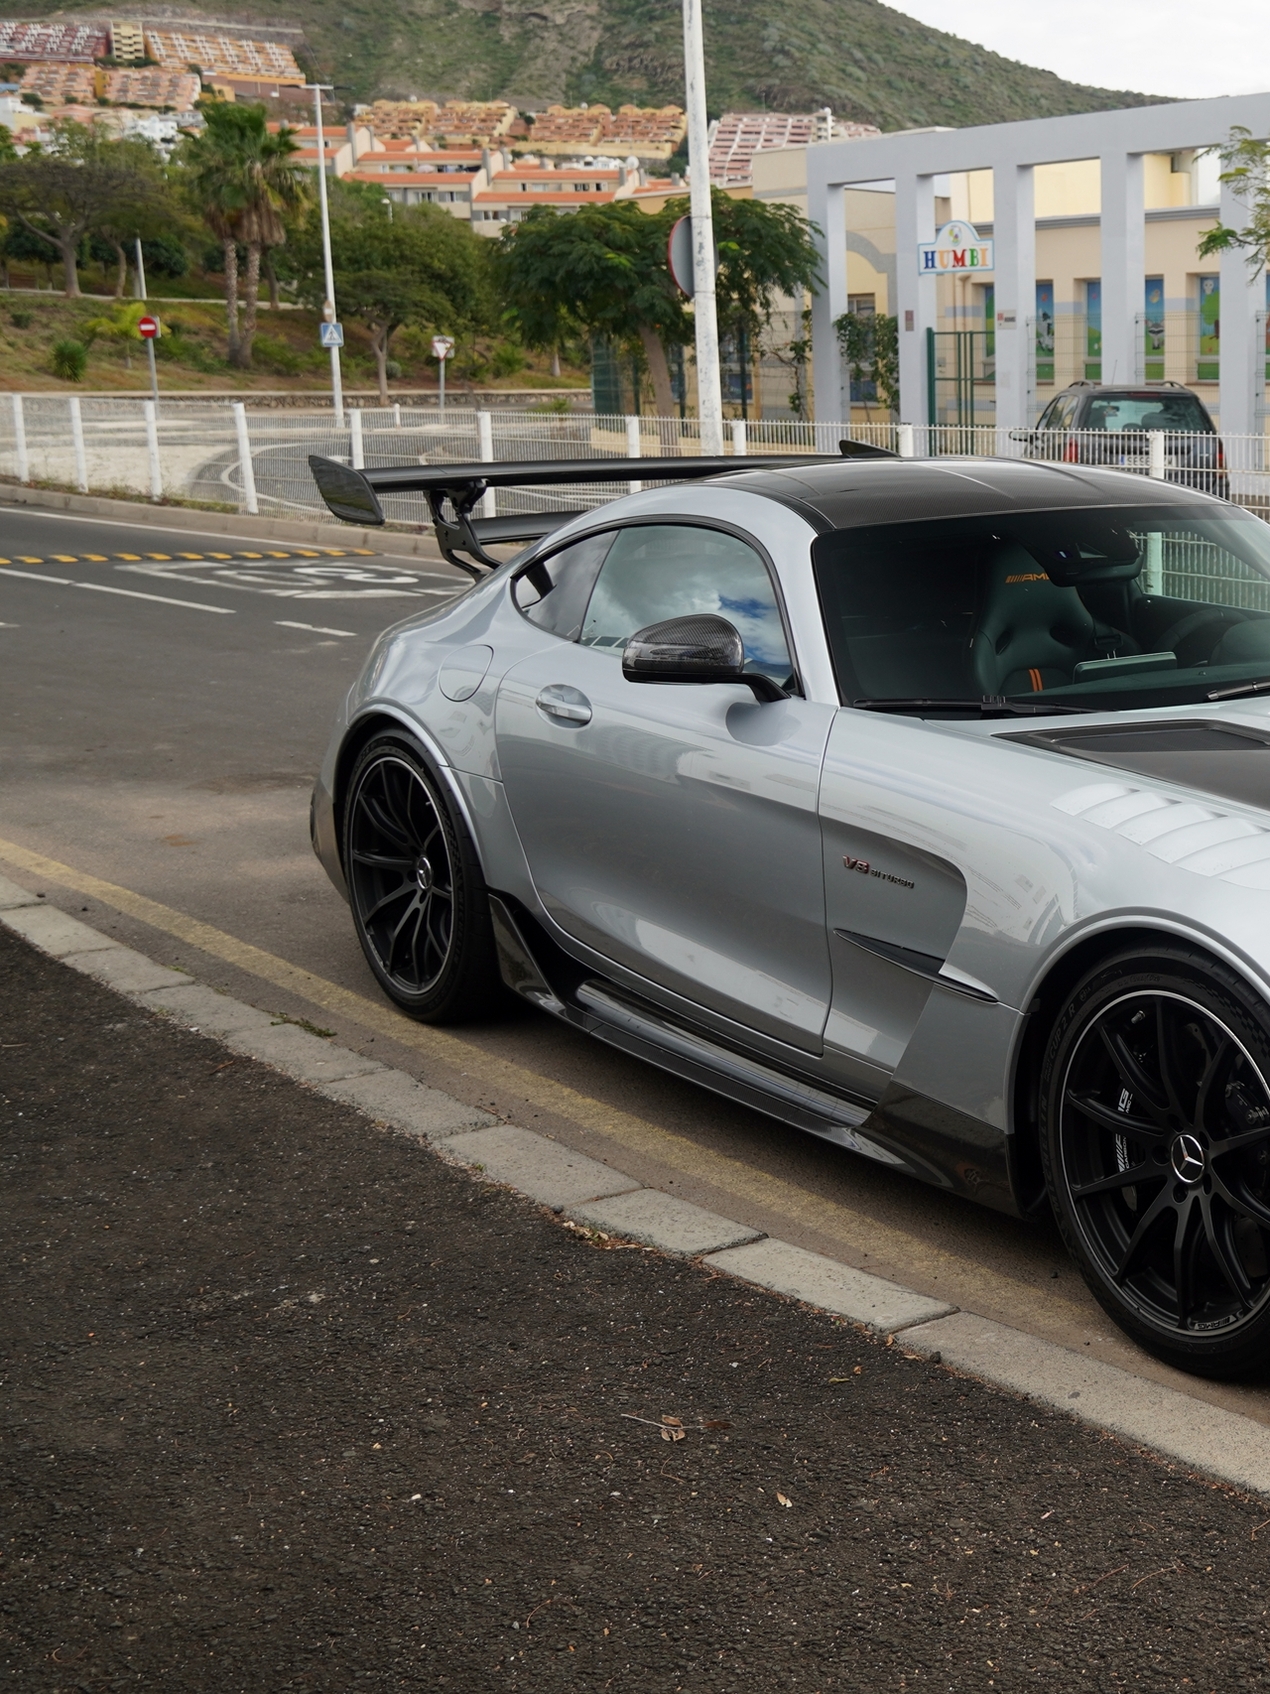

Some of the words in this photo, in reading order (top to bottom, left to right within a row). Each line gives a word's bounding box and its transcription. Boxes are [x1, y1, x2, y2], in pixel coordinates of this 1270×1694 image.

[923, 248, 988, 269] HUMBI
[842, 855, 870, 875] V8
[870, 868, 915, 889] BITURBO
[1047, 1027, 1064, 1060] CUP
[1039, 1094, 1061, 1216] MICHELIN
